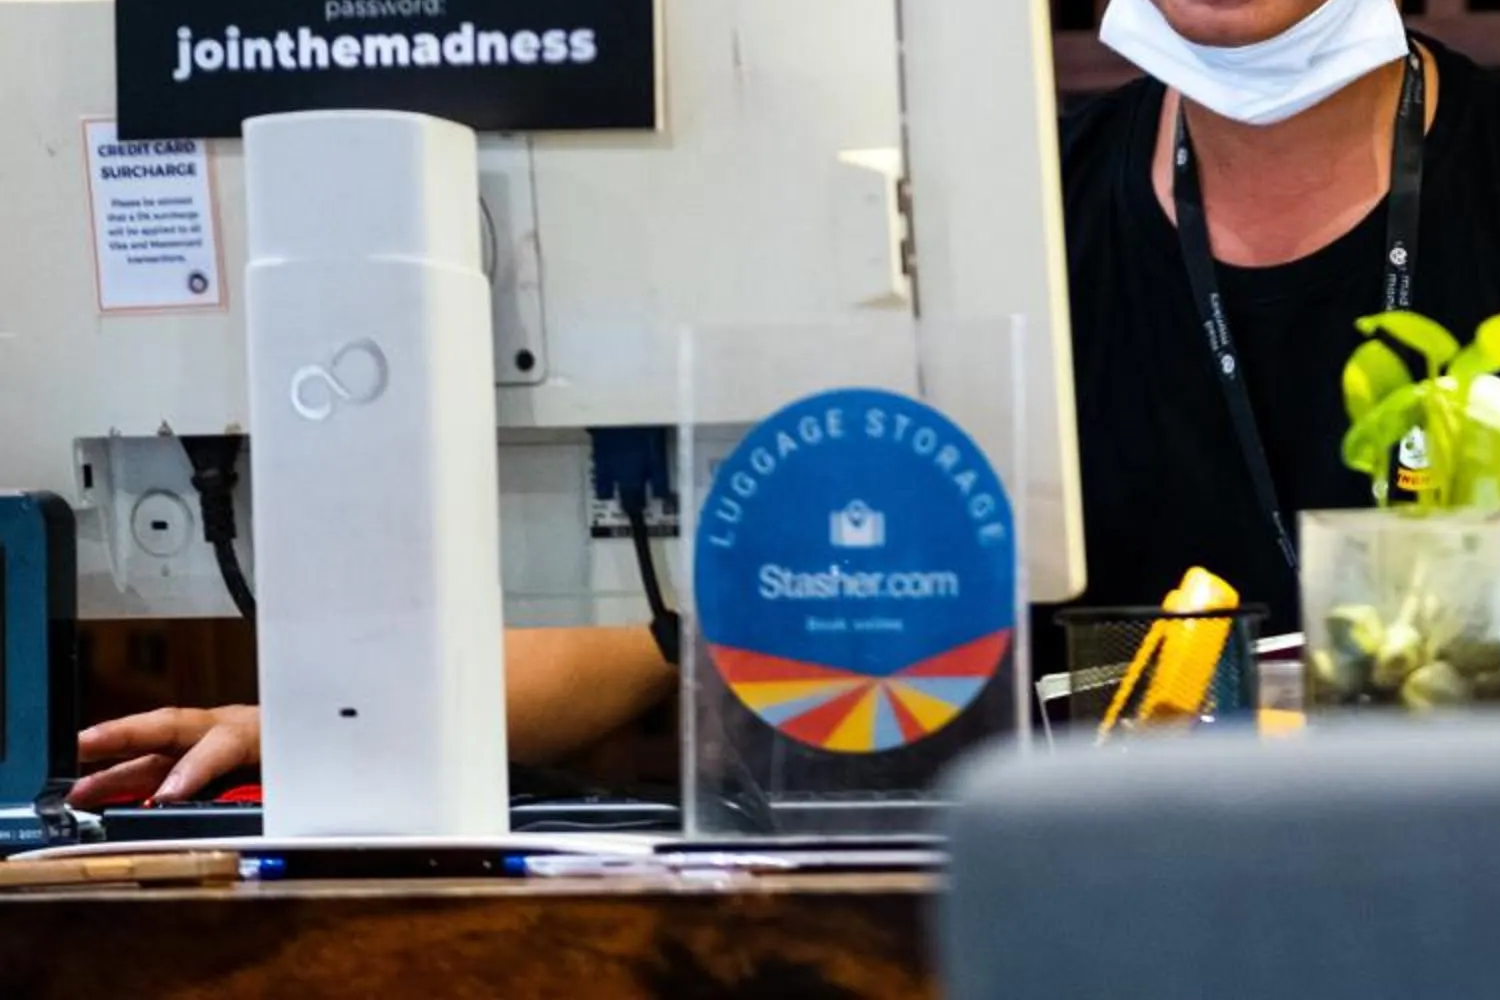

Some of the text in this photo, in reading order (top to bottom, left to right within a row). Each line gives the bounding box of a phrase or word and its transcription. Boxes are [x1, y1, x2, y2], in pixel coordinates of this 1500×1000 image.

[173, 22, 598, 82] jointhemadness
[97, 139, 197, 158] CREDIT CARD
[101, 162, 197, 180] SURCHARGE
[708, 408, 1006, 548] LUGGAGE STORAGE
[758, 563, 960, 600] Stasher.com
